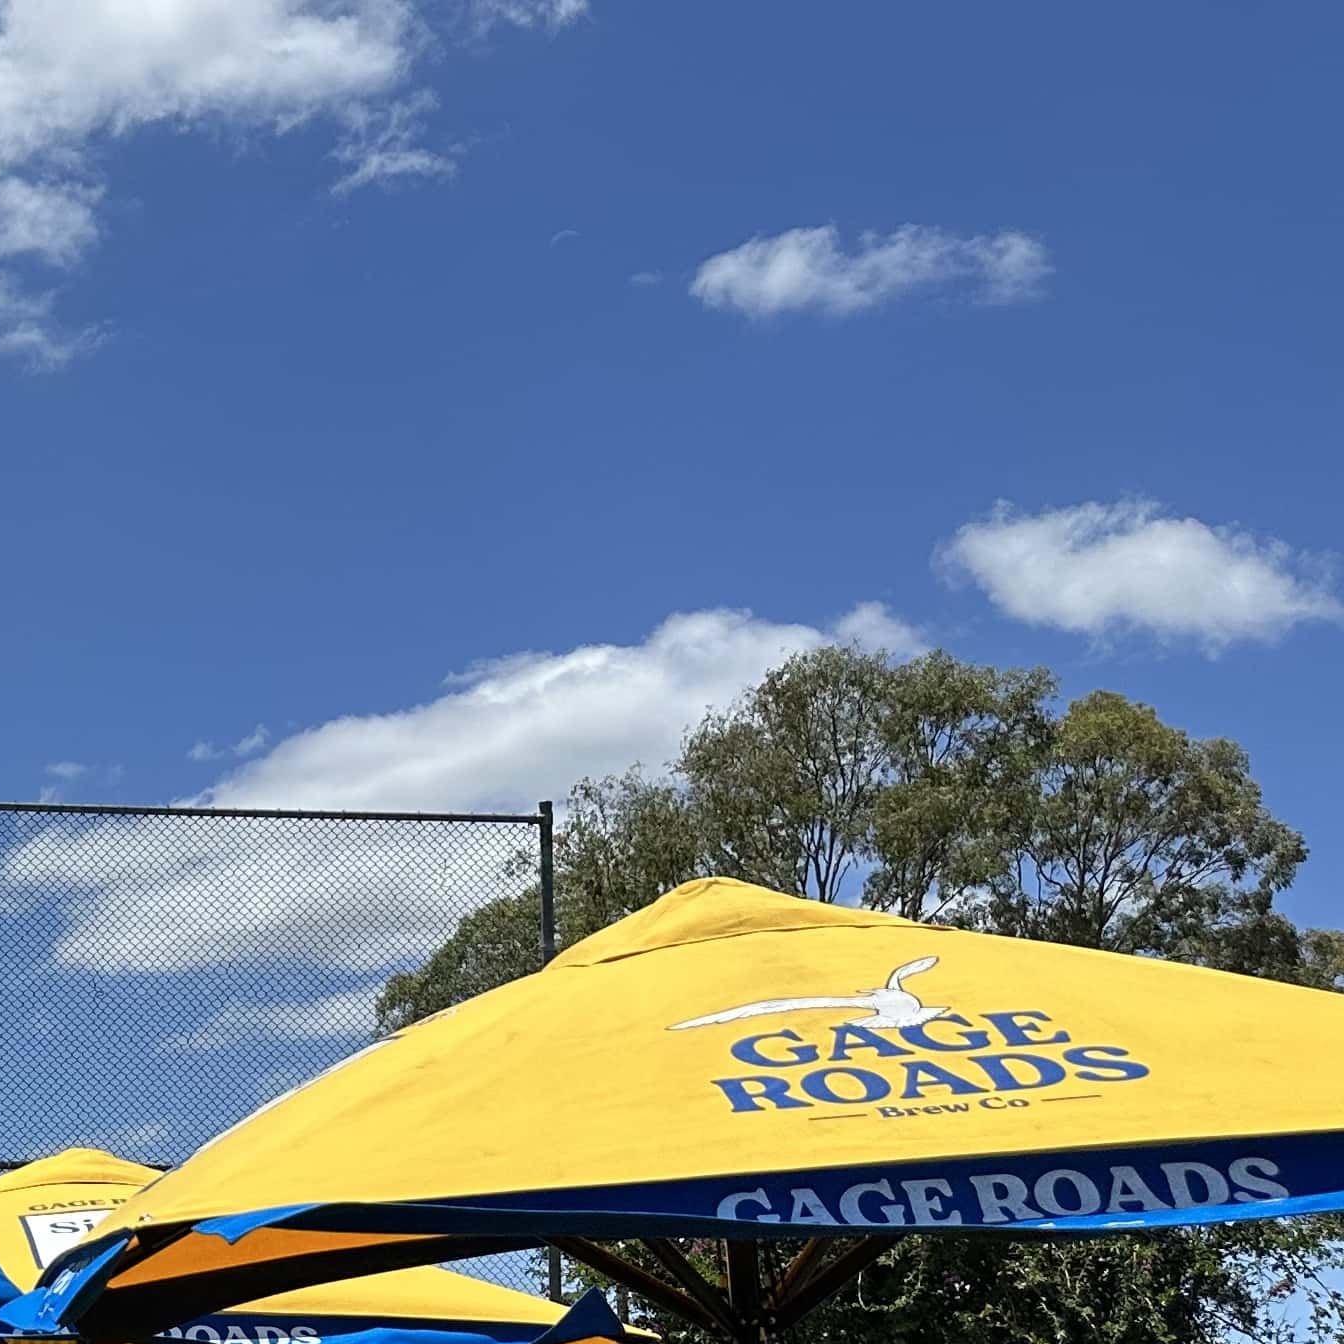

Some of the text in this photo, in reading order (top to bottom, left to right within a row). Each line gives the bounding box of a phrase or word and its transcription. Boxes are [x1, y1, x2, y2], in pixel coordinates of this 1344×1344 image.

[730, 1009, 1072, 1069] GAGE
[712, 1045, 1150, 1113] ROADS
[878, 1094, 1030, 1120] Brew Co
[29, 1199, 106, 1211] GAGE
[716, 1156, 1291, 1226] GAGE ROADS
